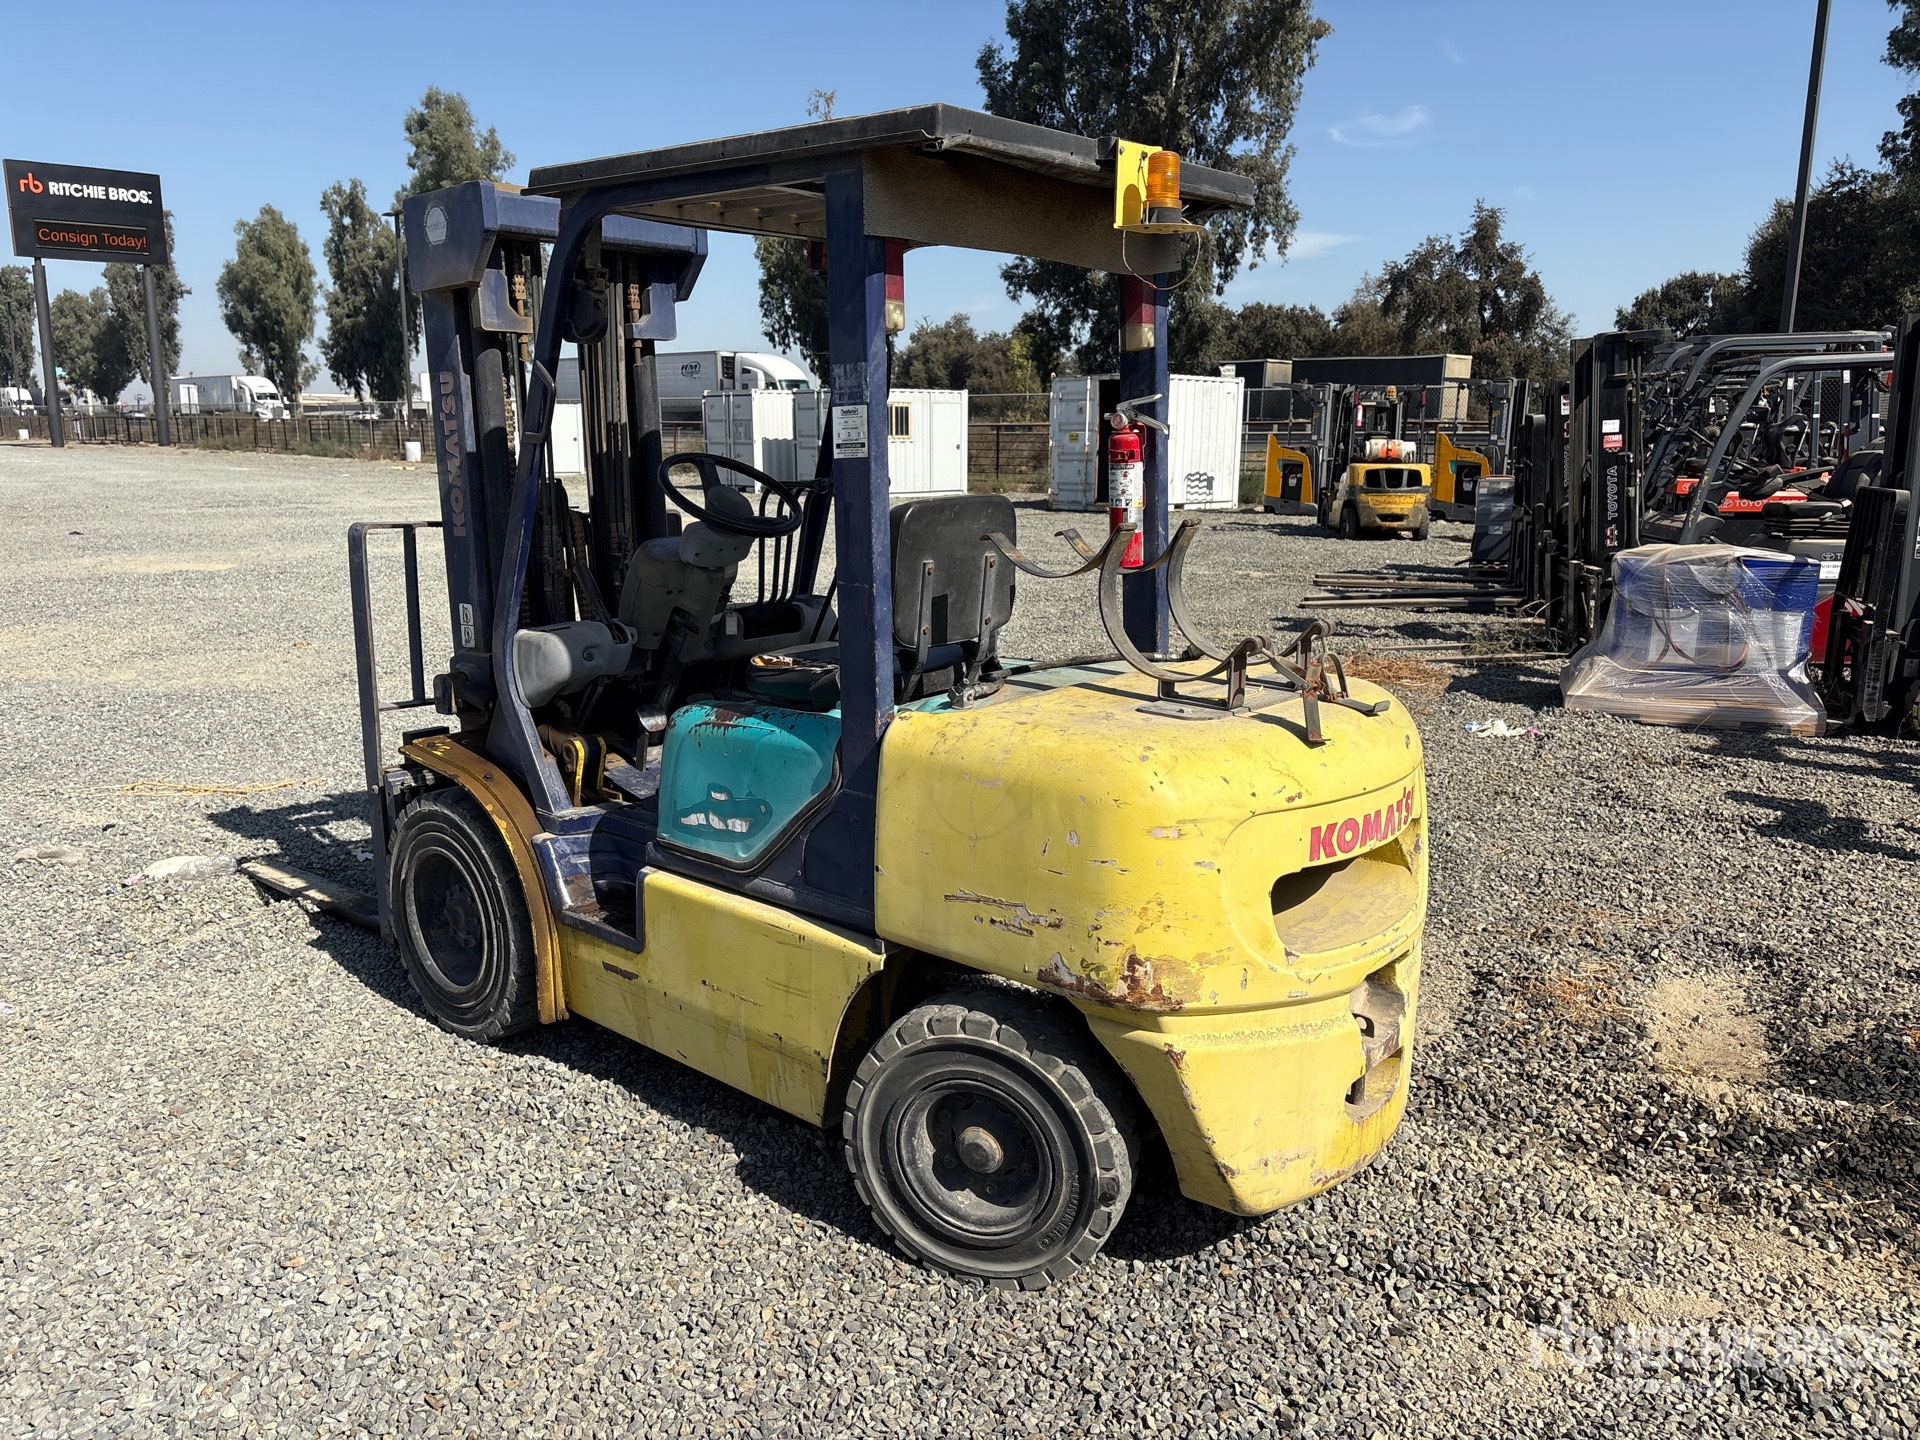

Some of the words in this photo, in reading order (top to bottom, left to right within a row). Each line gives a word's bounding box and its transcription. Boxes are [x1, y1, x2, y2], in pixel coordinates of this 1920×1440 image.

[19, 172, 44, 194] rb
[48, 181, 107, 199] RITCHIE
[108, 187, 153, 204] BROS.
[38, 228, 98, 247] Consign
[102, 232, 148, 250] Today!
[440, 371, 467, 537] KOMATSU
[1607, 465, 1618, 520] TOYOTA
[1735, 499, 1769, 508] TOYOT
